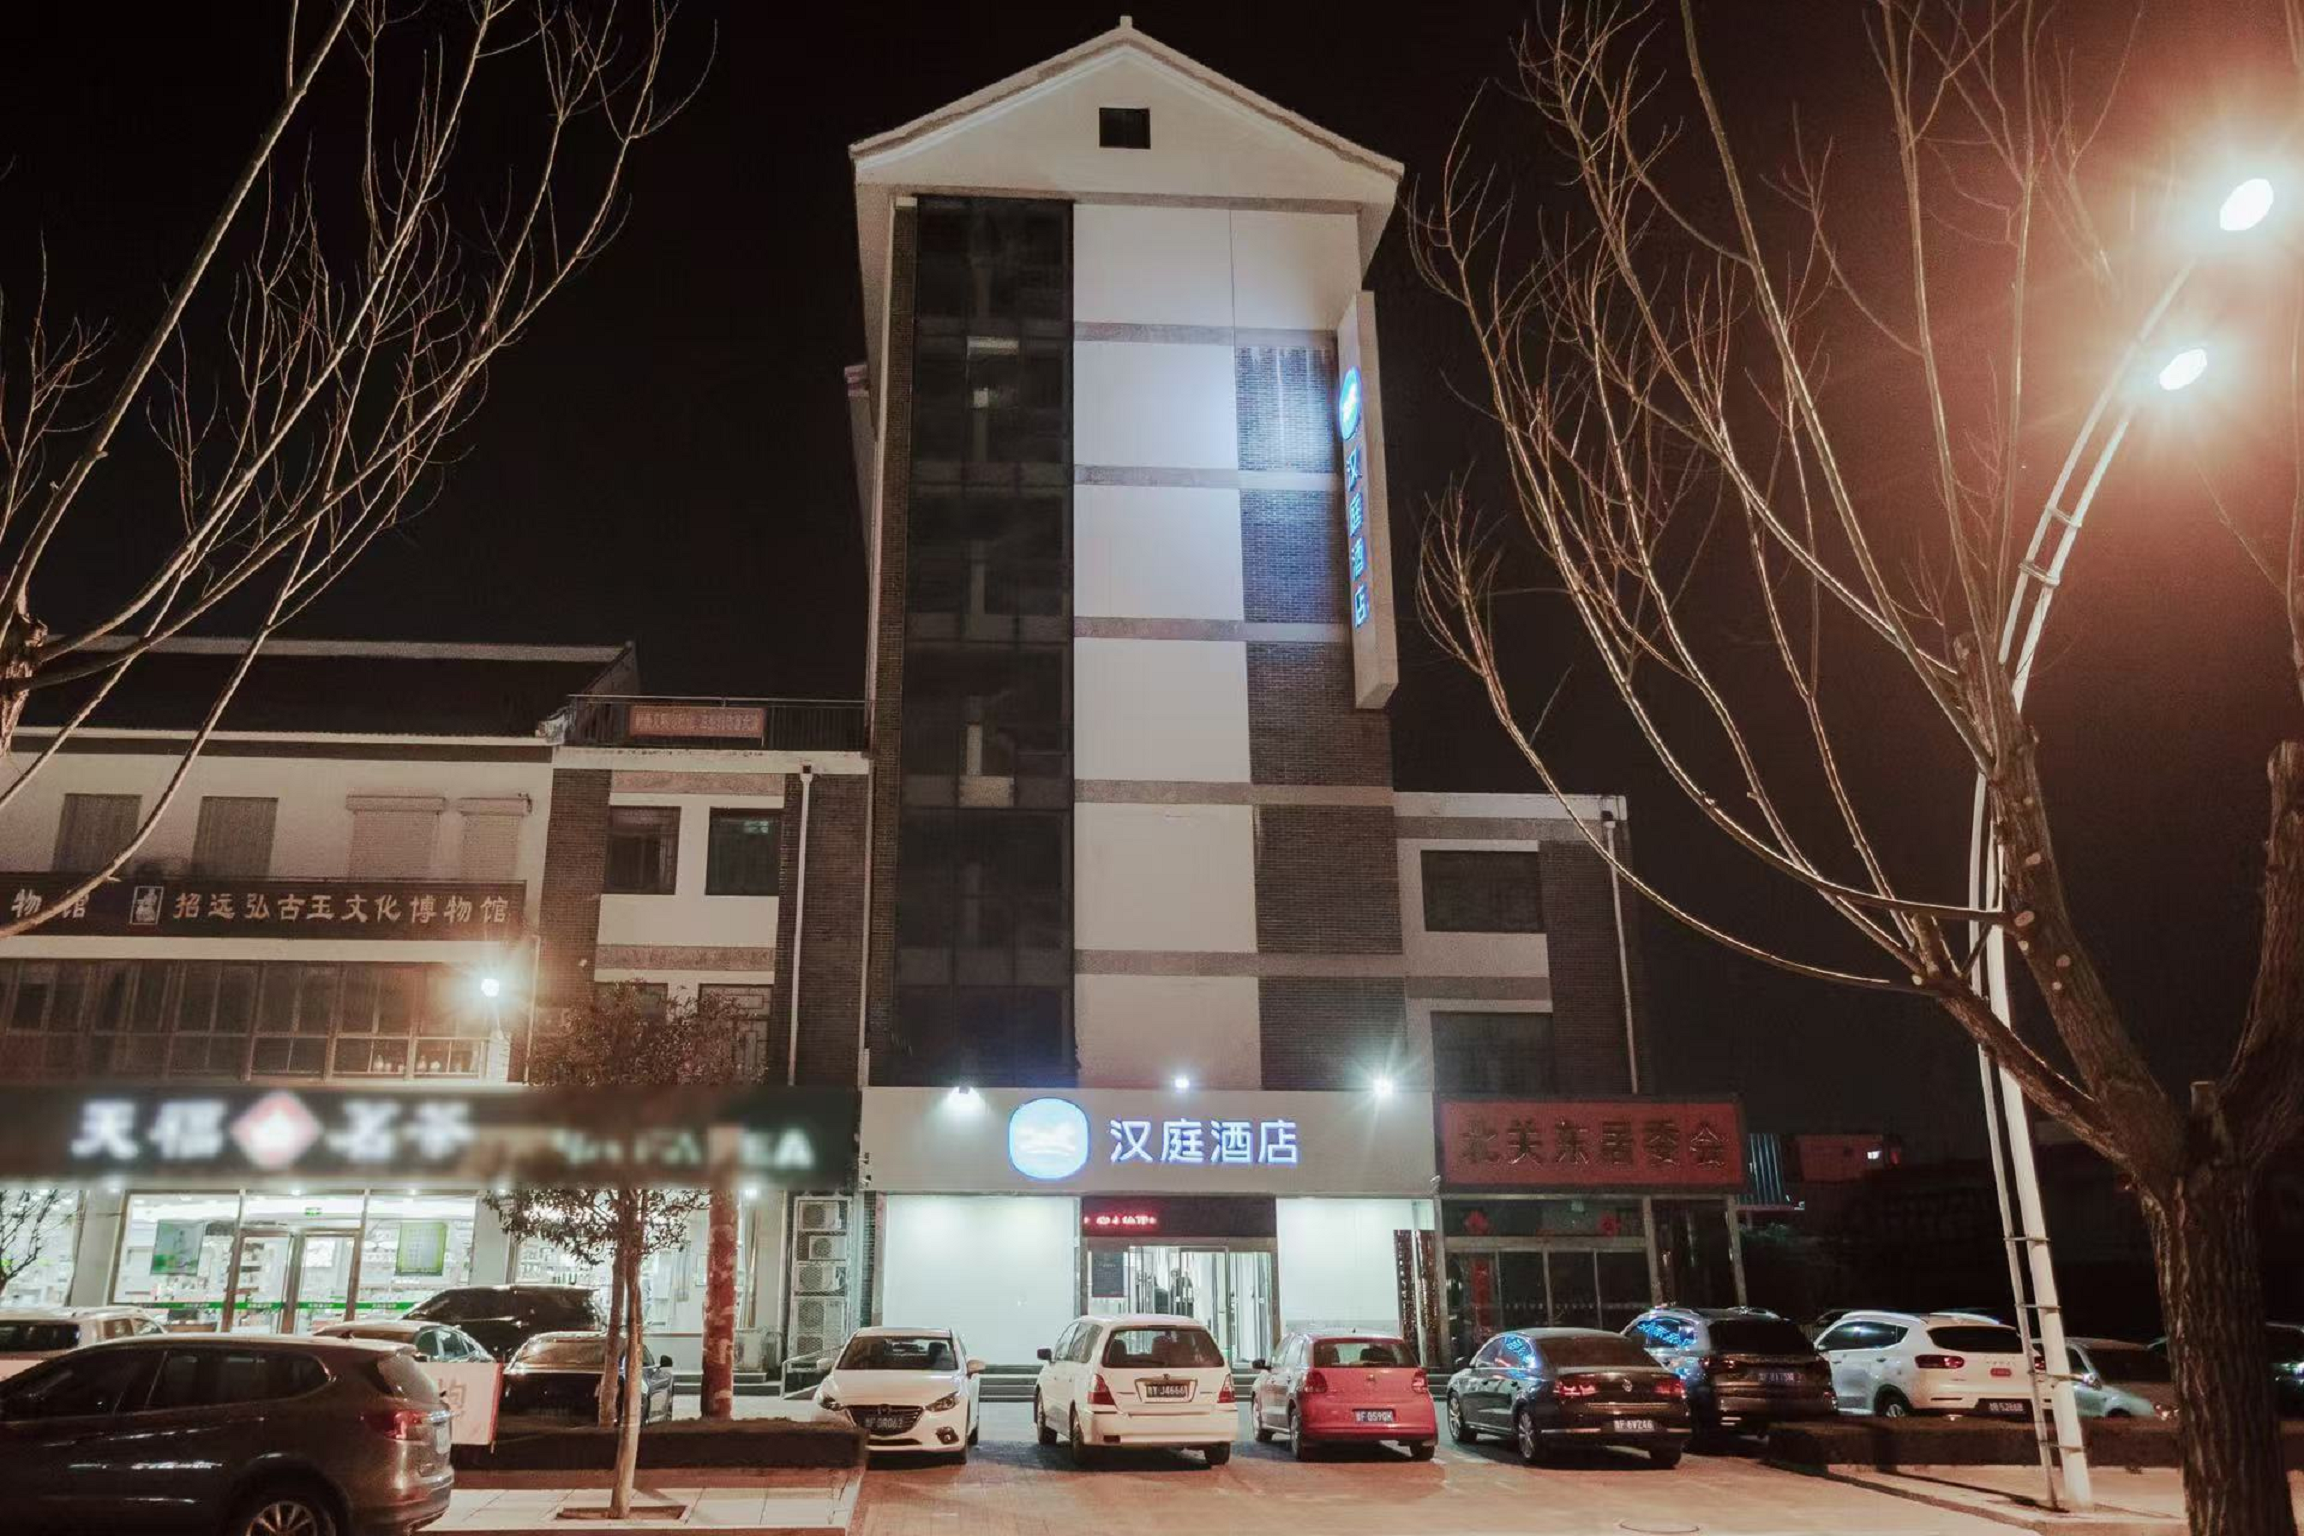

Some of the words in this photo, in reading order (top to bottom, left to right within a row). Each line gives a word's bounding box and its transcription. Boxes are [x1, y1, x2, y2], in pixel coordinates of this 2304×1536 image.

[173, 891, 510, 925] 招远弘古玉文化博物馆
[1105, 1118, 1297, 1163] 汉庭酒店
[1460, 1117, 1729, 1168] 北关东居委会
